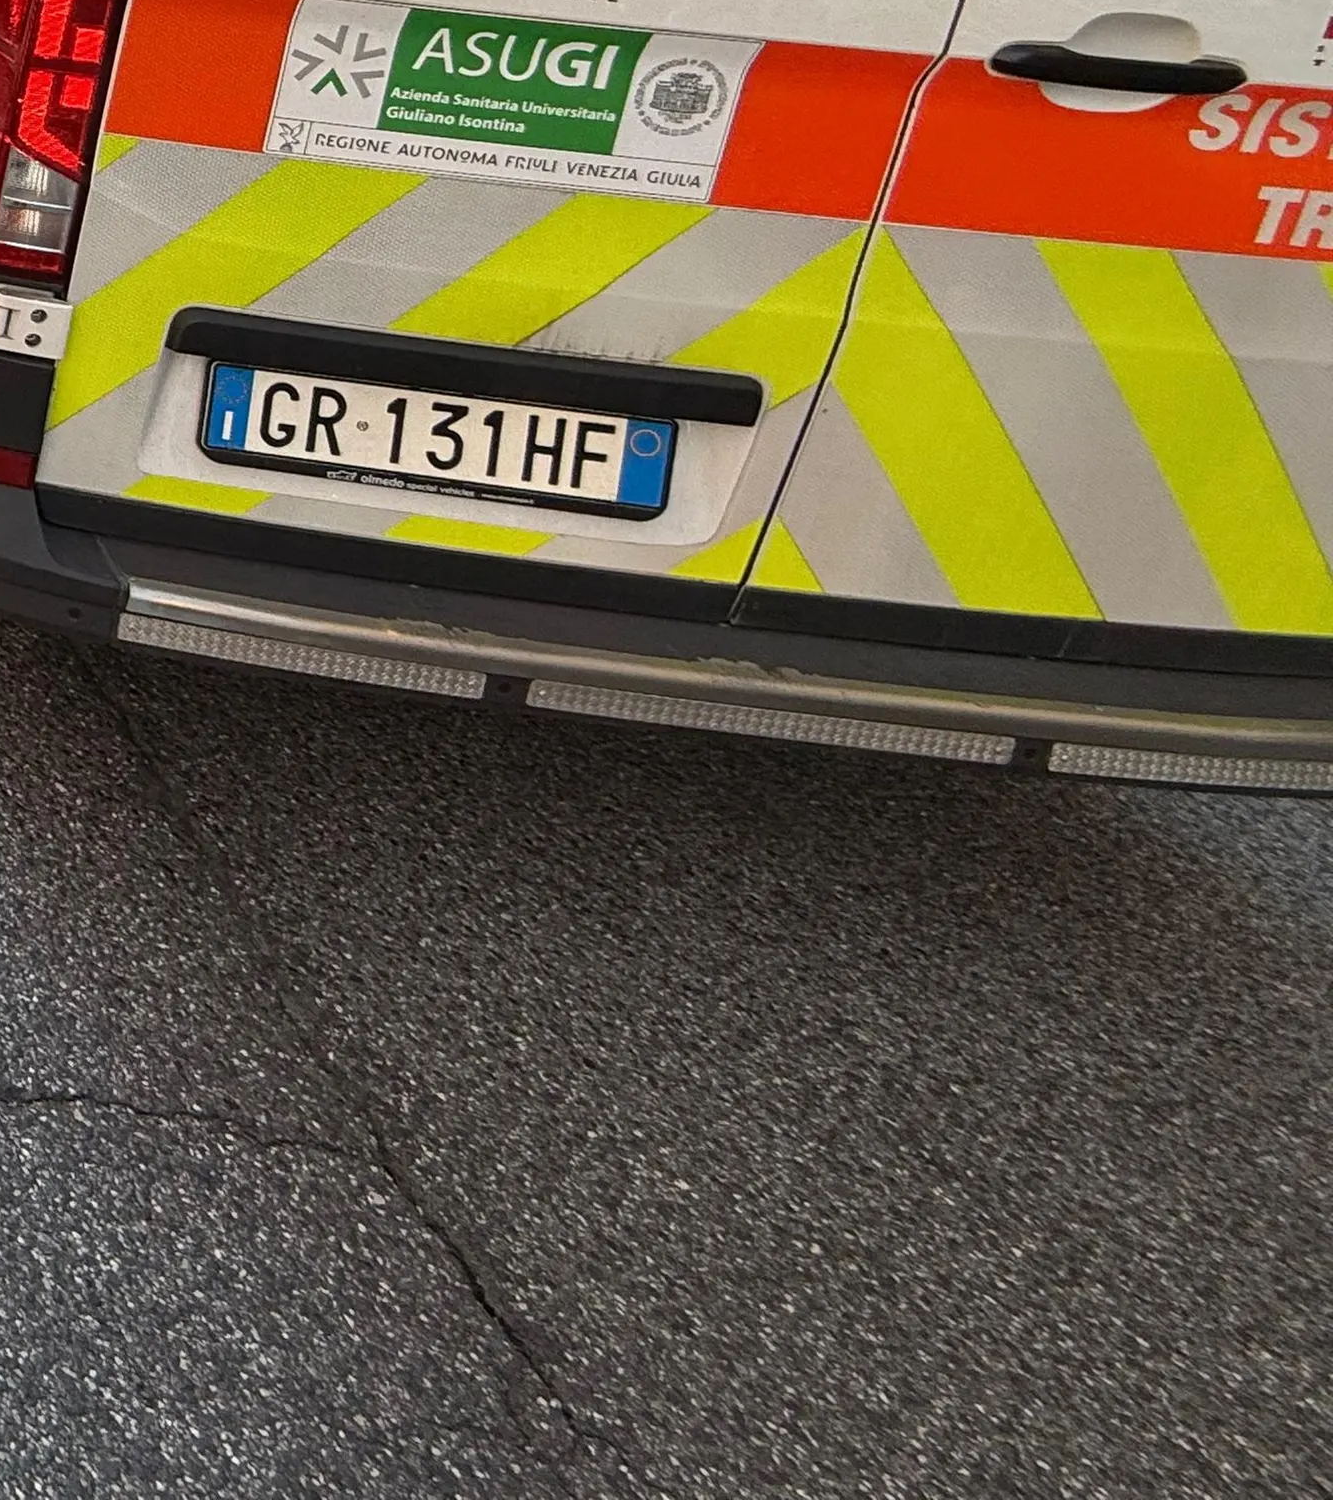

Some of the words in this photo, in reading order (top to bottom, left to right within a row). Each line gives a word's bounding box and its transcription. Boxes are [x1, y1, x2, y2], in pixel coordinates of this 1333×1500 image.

[412, 27, 621, 90] ASUGI
[386, 106, 455, 126] Giuliano
[458, 113, 525, 134] Isontina
[390, 86, 450, 104] Azienda
[453, 93, 519, 113] Sanitaria
[521, 101, 617, 122] Universitaria
[1188, 93, 1333, 161] SIS
[315, 133, 392, 154] REGIONE
[397, 143, 498, 167] AUTONOMA
[505, 155, 557, 174] FRIULI
[566, 160, 638, 182] VENEZIA
[258, 381, 348, 457] GR
[385, 396, 616, 490] 131HF
[360, 473, 405, 489] olmedo
